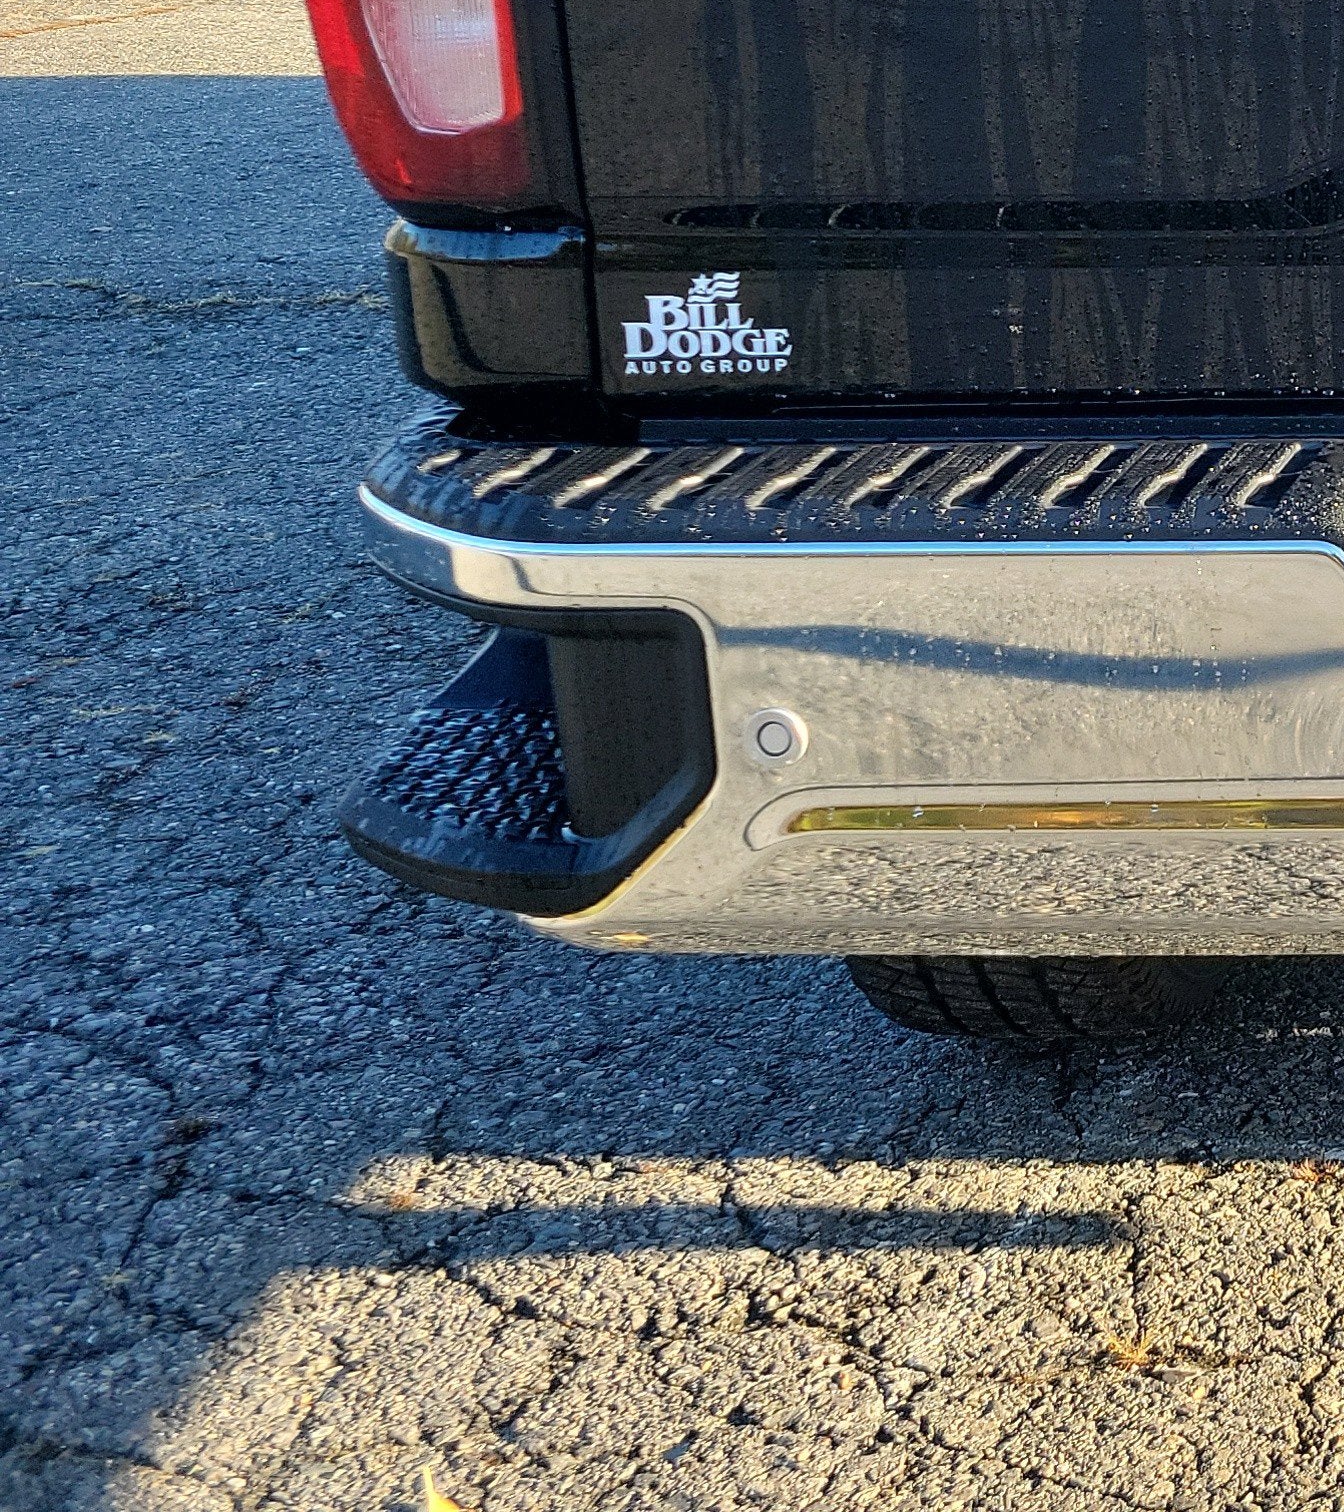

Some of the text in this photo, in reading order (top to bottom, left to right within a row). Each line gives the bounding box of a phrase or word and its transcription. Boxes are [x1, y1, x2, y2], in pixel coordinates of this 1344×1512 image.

[644, 295, 754, 330] BILL
[621, 322, 793, 358] DODGE
[624, 358, 788, 374] AUTO GROUP
